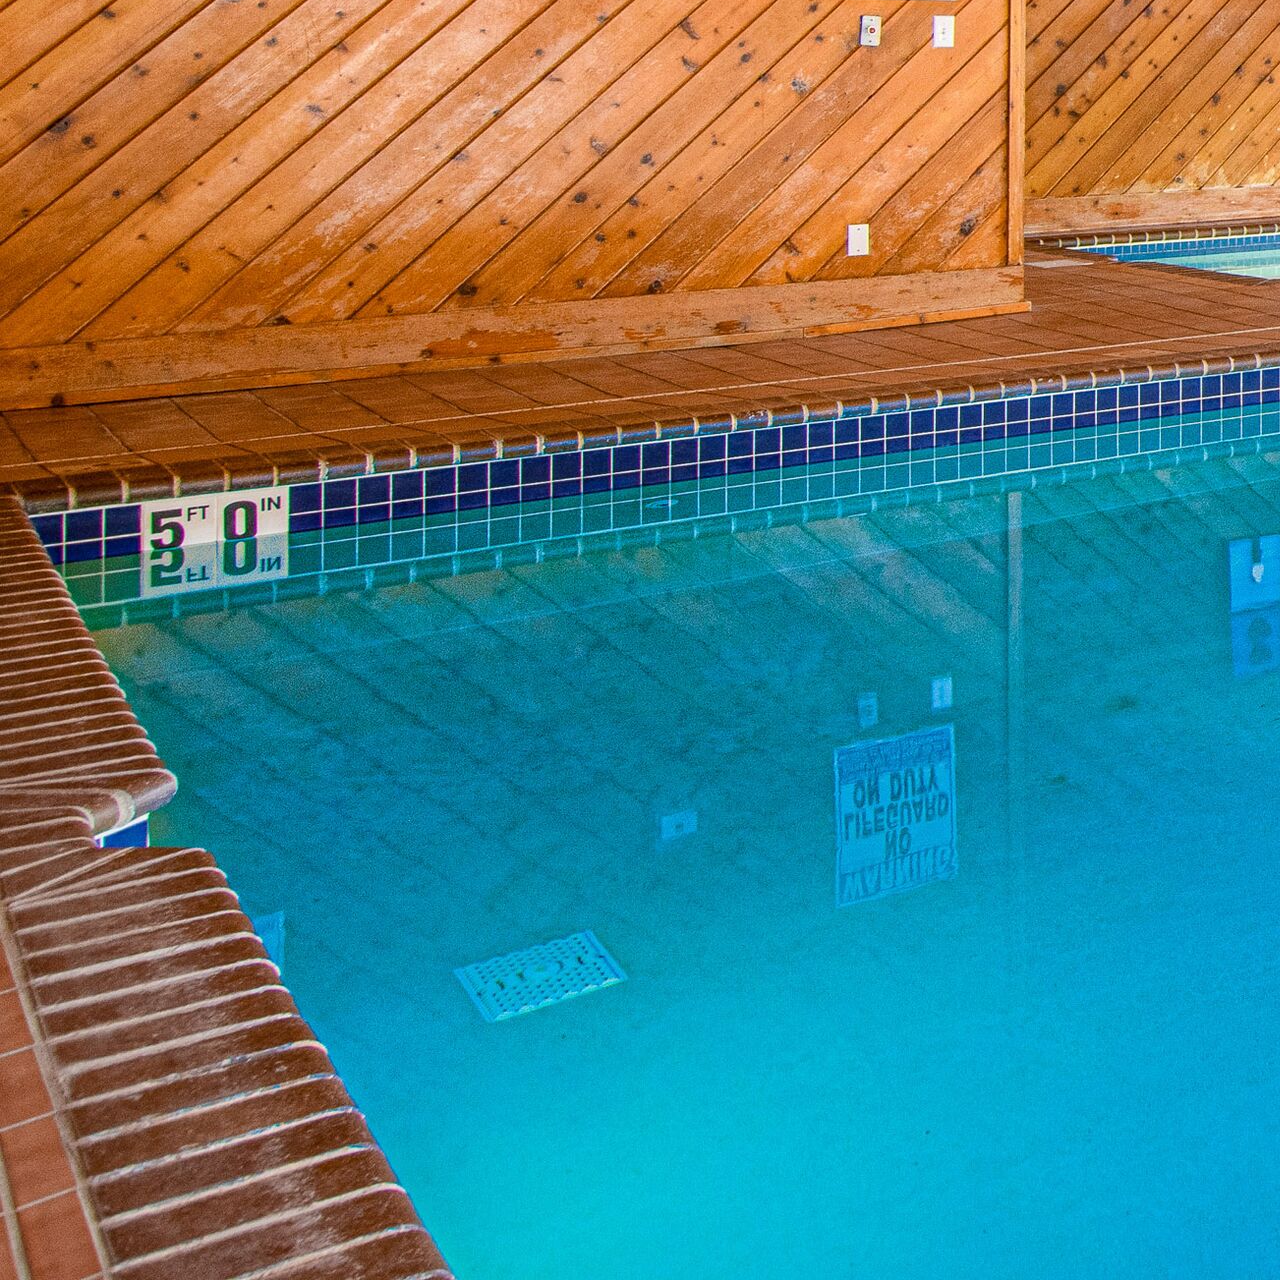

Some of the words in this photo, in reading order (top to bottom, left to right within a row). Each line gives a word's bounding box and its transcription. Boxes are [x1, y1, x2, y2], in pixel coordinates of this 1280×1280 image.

[150, 508, 185, 550] 5
[187, 505, 209, 522] FT
[223, 500, 258, 541] 0
[261, 496, 281, 512] IN
